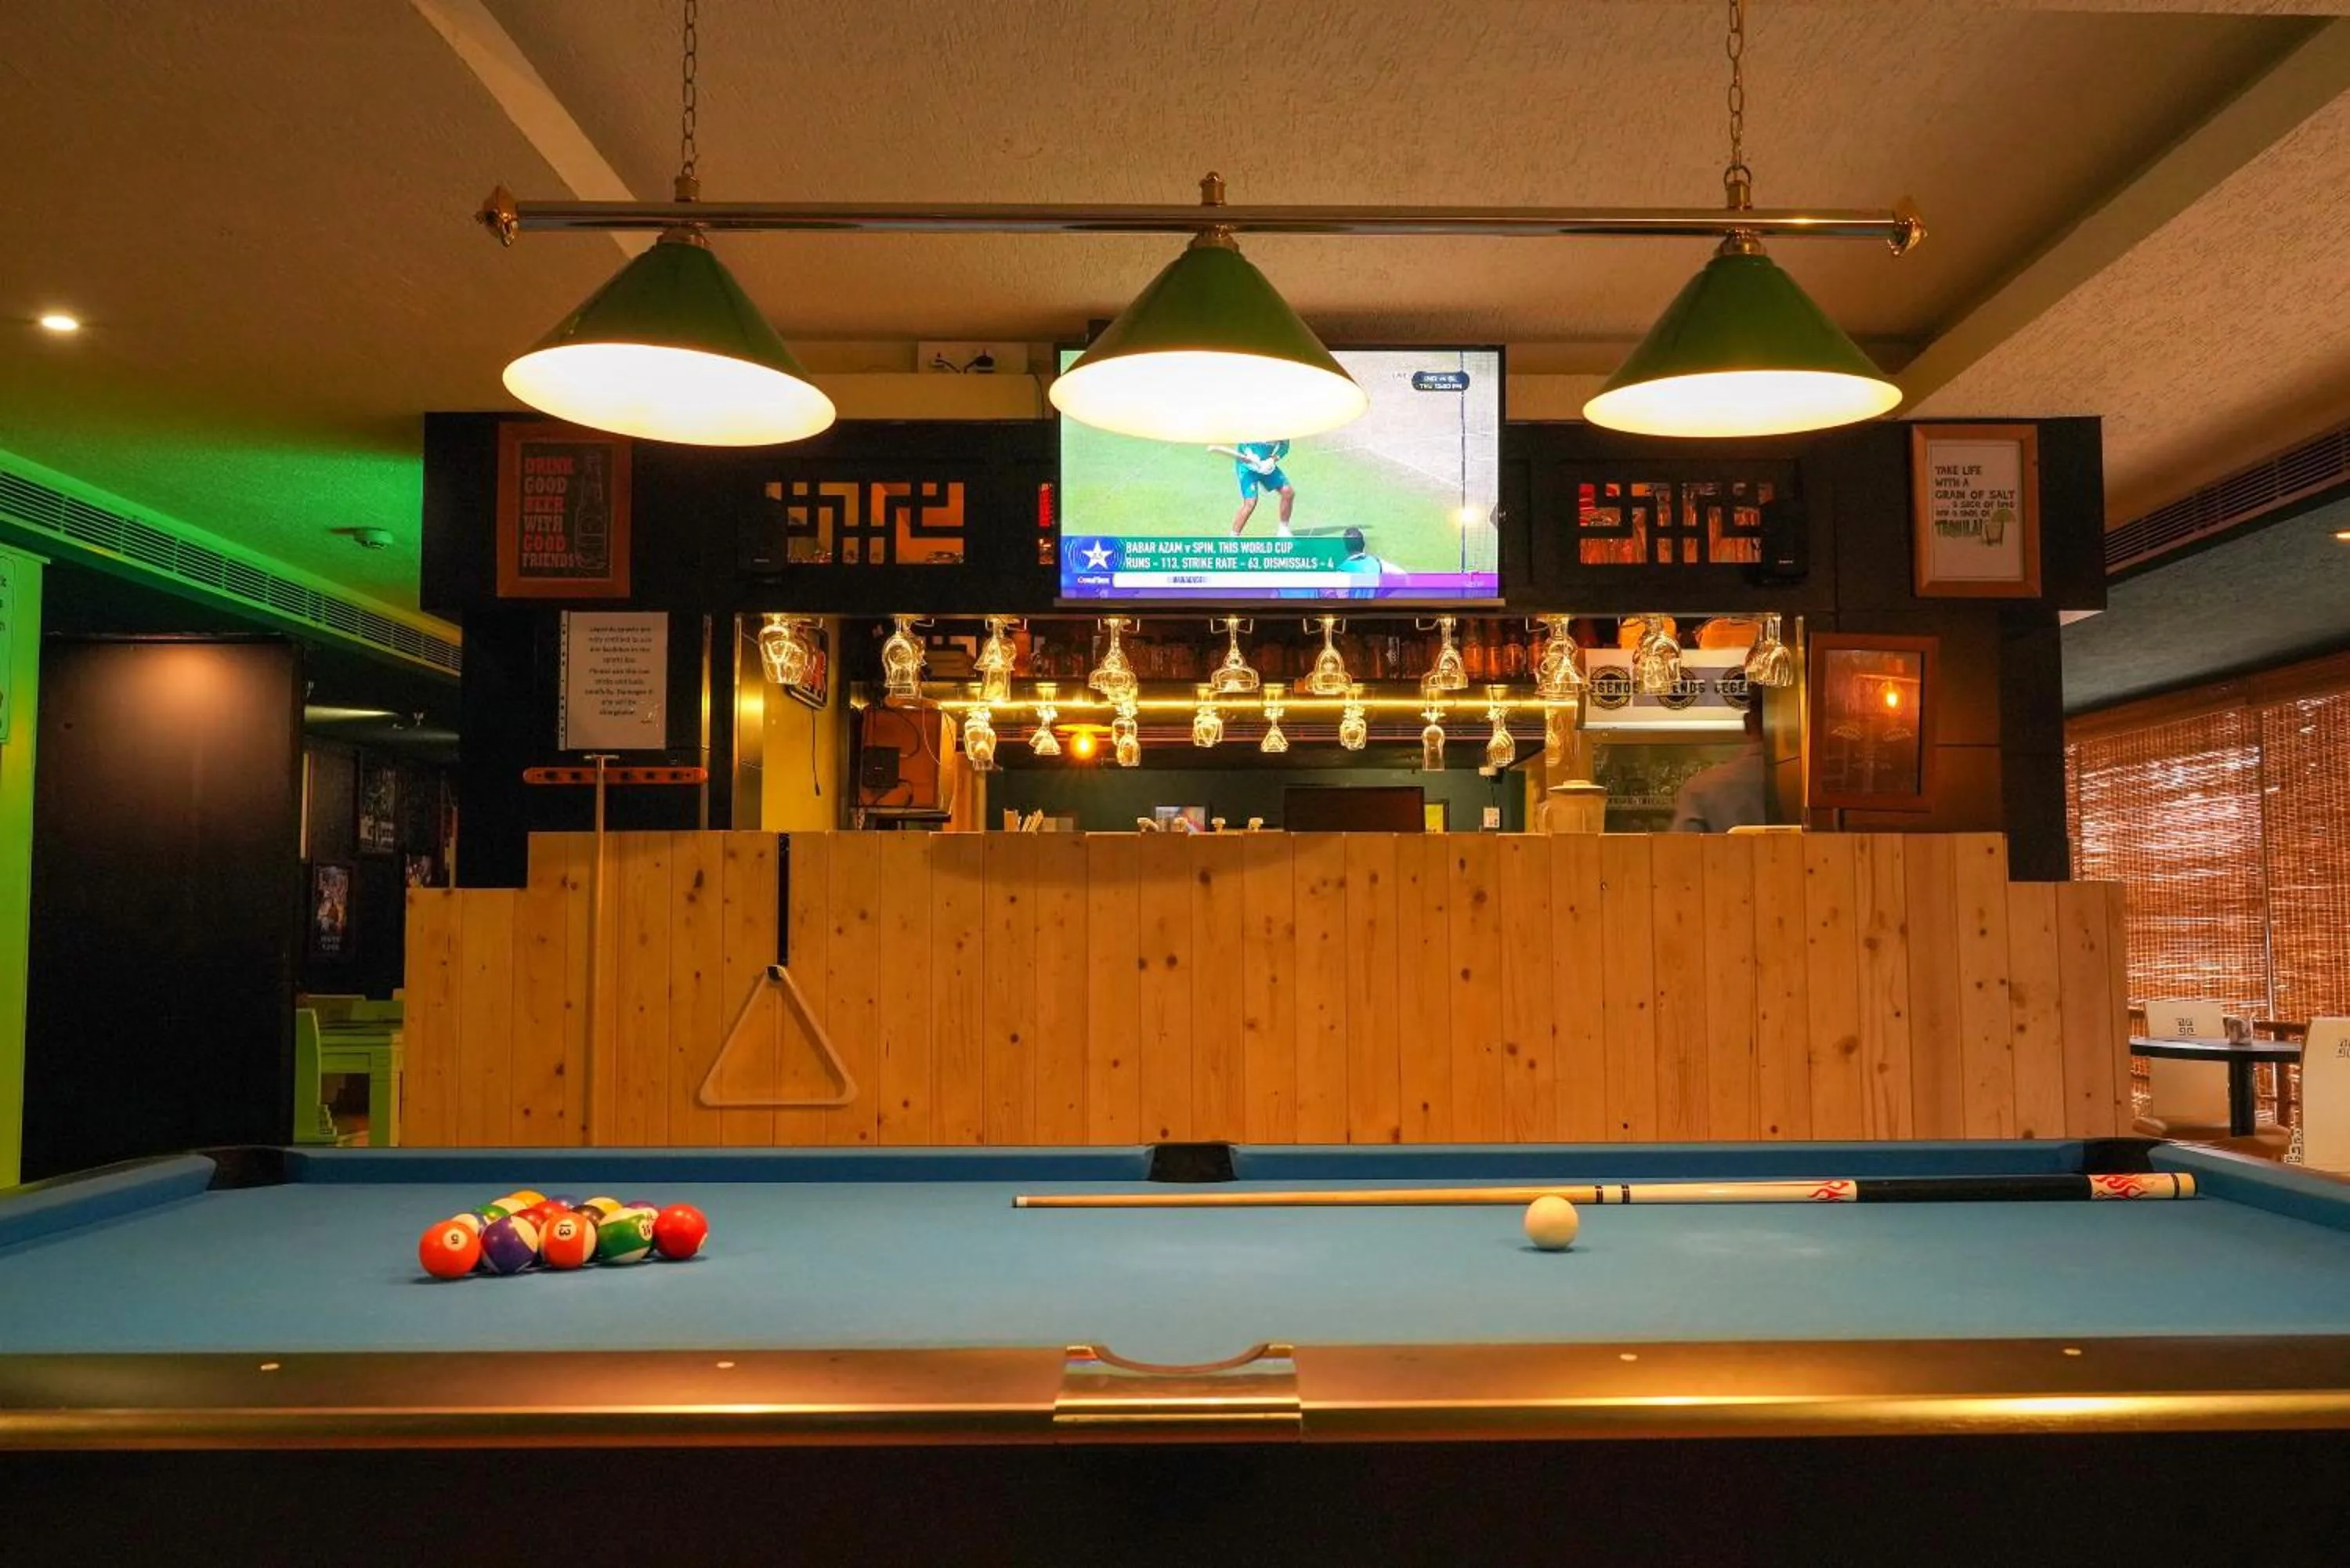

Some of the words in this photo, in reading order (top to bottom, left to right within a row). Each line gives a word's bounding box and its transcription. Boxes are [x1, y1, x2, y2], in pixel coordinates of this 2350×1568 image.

[1934, 465, 1958, 475] TAKE
[1962, 465, 1982, 475] LIFE
[524, 476, 567, 494] GOOD
[1935, 478, 1960, 487] WITH
[1962, 478, 1969, 487] A
[1935, 490, 1965, 500] GRAIN
[1970, 490, 1985, 500] OF
[1987, 490, 2016, 500] SALT
[522, 515, 563, 533] WITH
[523, 533, 566, 552] GOOD
[1126, 541, 1156, 554] BABAR
[1159, 541, 1183, 554] AZAM
[1219, 541, 1238, 554] THIS
[1240, 541, 1273, 554] WORLD
[1275, 541, 1293, 554] CUP
[522, 552, 576, 568] FRIENDS
[1126, 557, 1151, 569] RUNS
[1181, 557, 1213, 569] STRIKE
[1215, 557, 1238, 569] RATE
[1264, 557, 1318, 569] DISMISSALS
[559, 1224, 572, 1237] 13
[450, 1234, 459, 1245] 5
